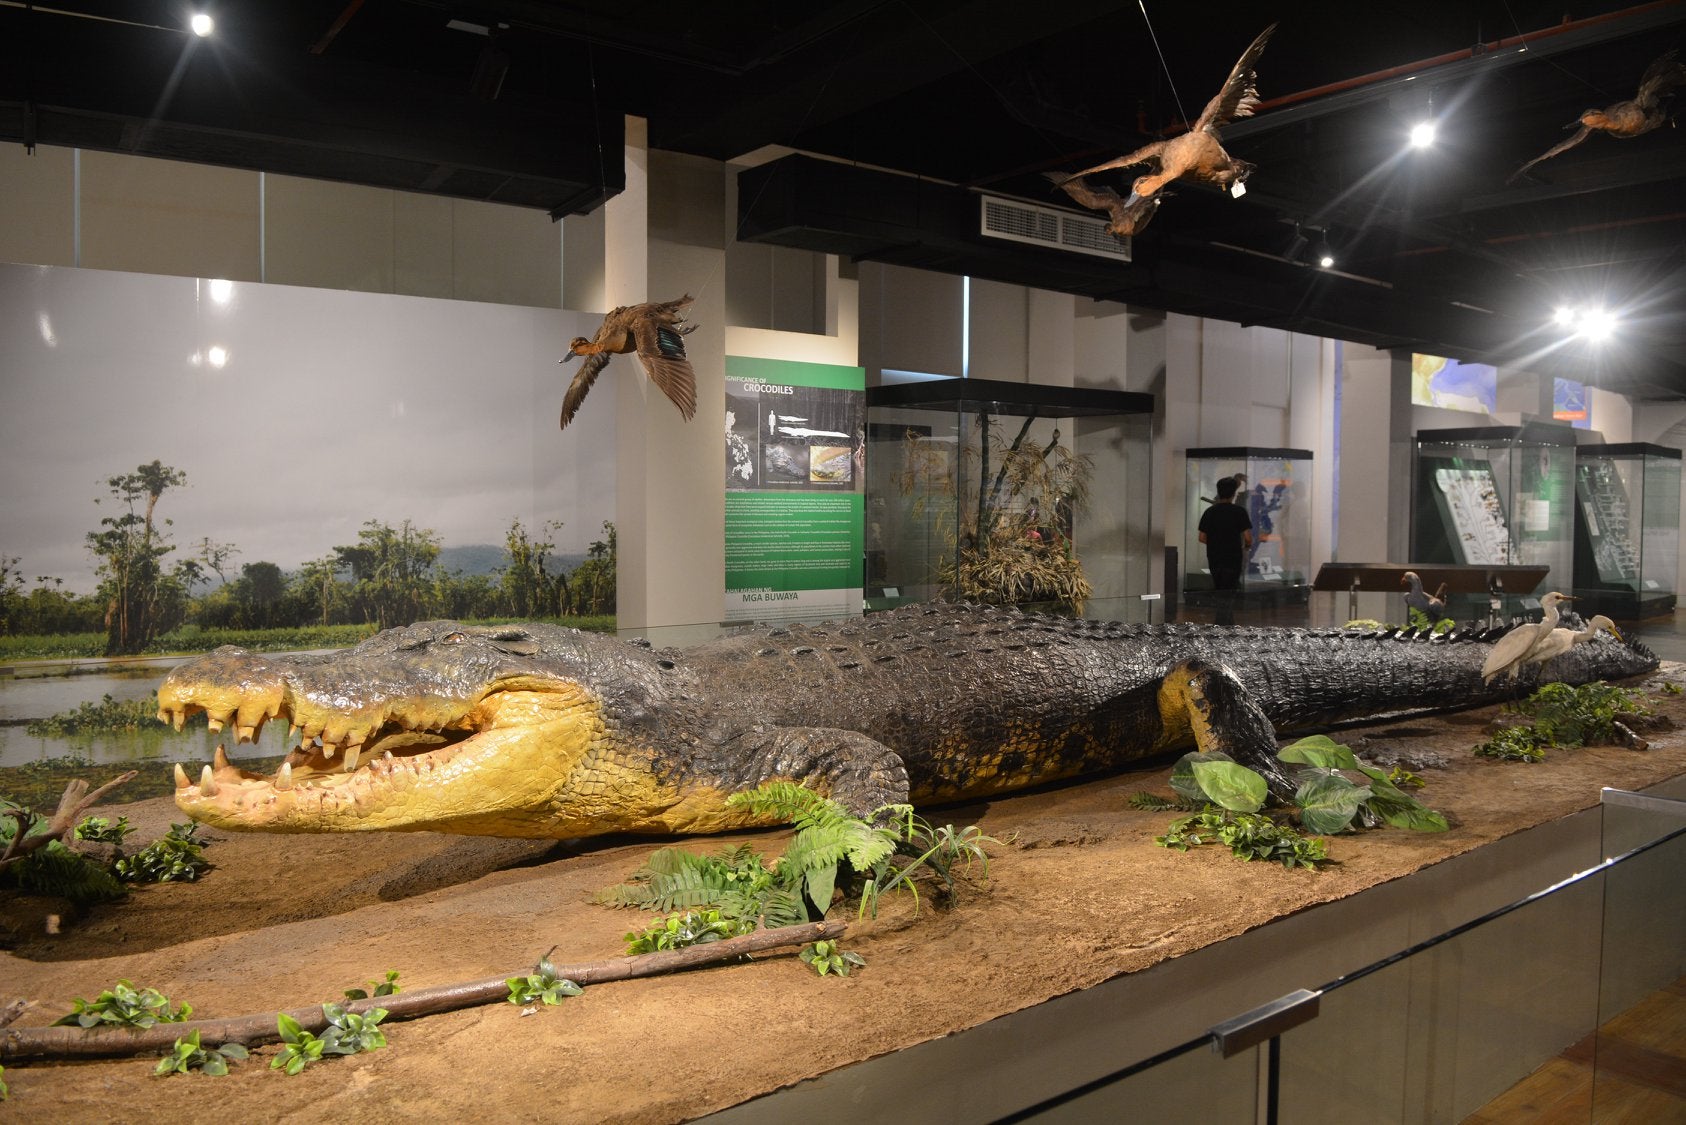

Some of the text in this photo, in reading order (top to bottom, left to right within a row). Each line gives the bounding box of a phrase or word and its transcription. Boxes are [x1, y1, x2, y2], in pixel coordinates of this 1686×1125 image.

[725, 375, 758, 384] IGNIFICANCE
[743, 383, 794, 395] CROCODILES
[742, 592, 799, 603] MGA BUWAYA
